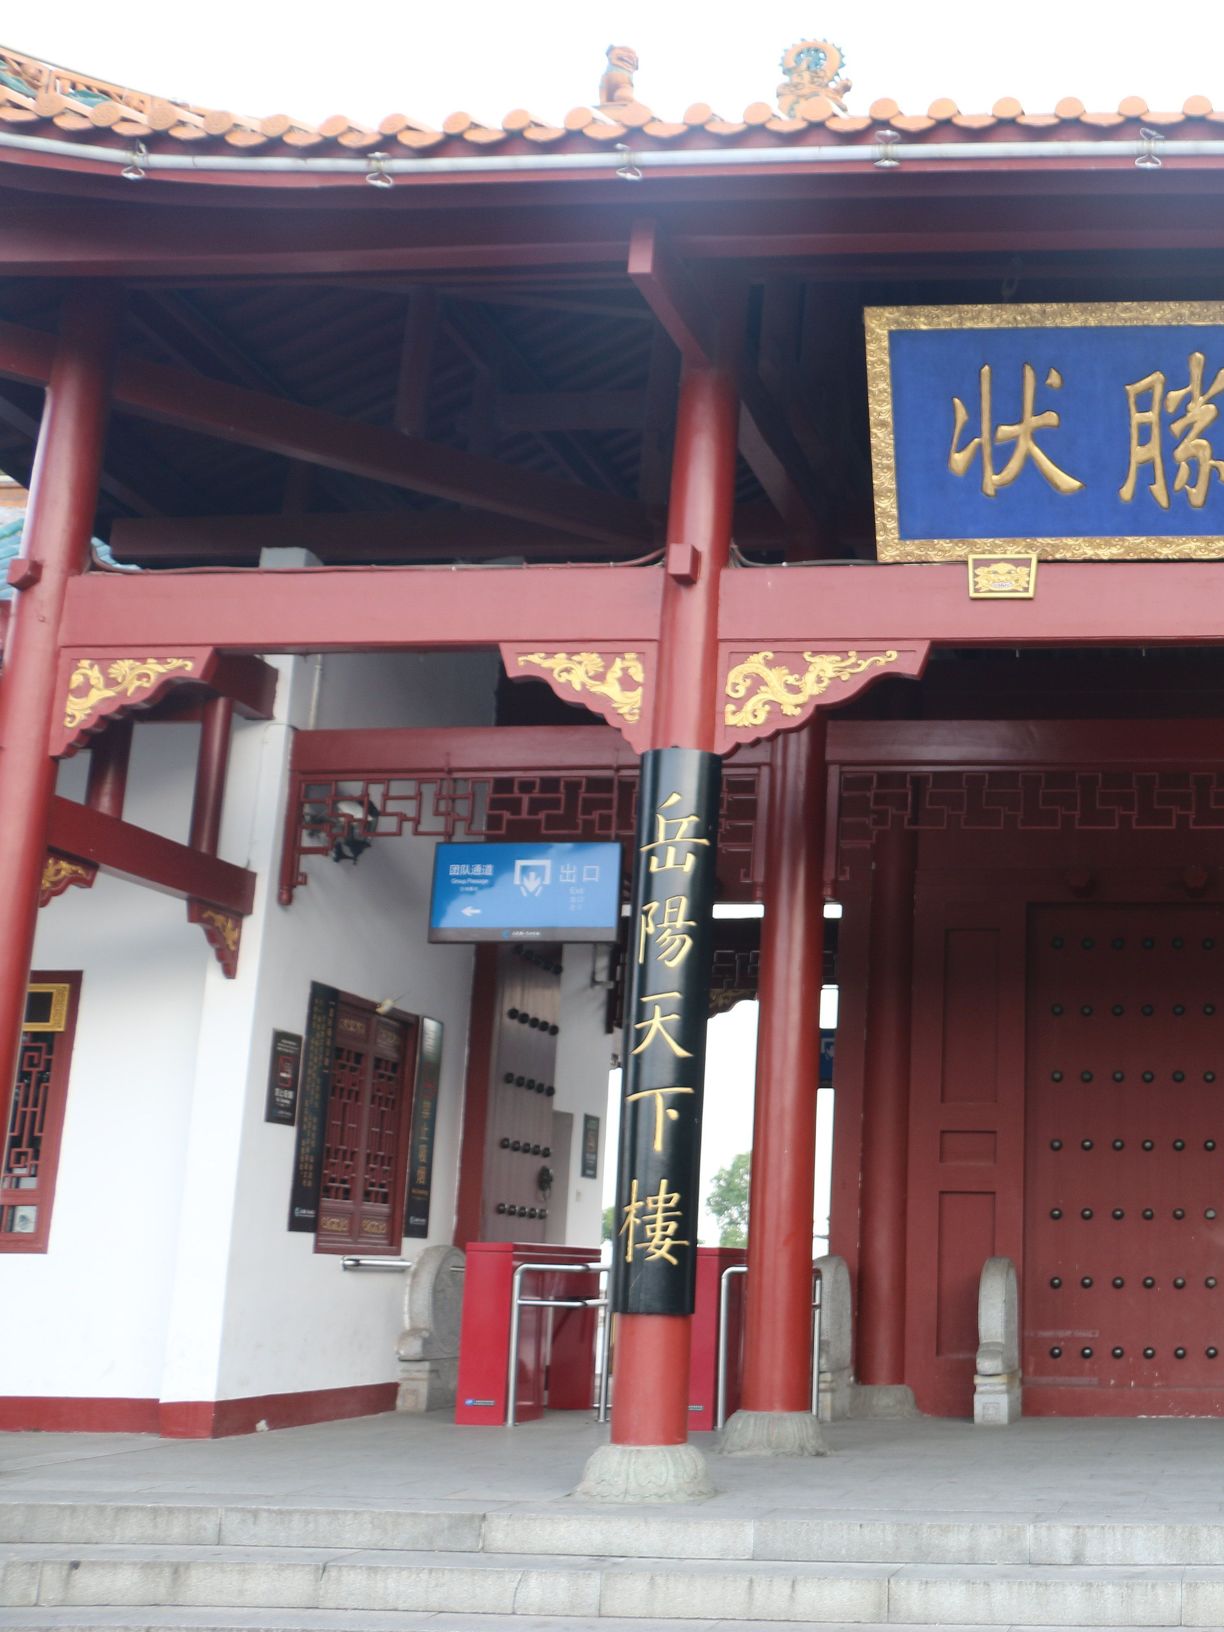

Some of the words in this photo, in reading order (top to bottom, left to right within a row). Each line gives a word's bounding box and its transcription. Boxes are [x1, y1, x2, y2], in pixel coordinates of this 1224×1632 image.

[449, 864, 493, 876] 团队通道
[560, 864, 600, 883] 出口
